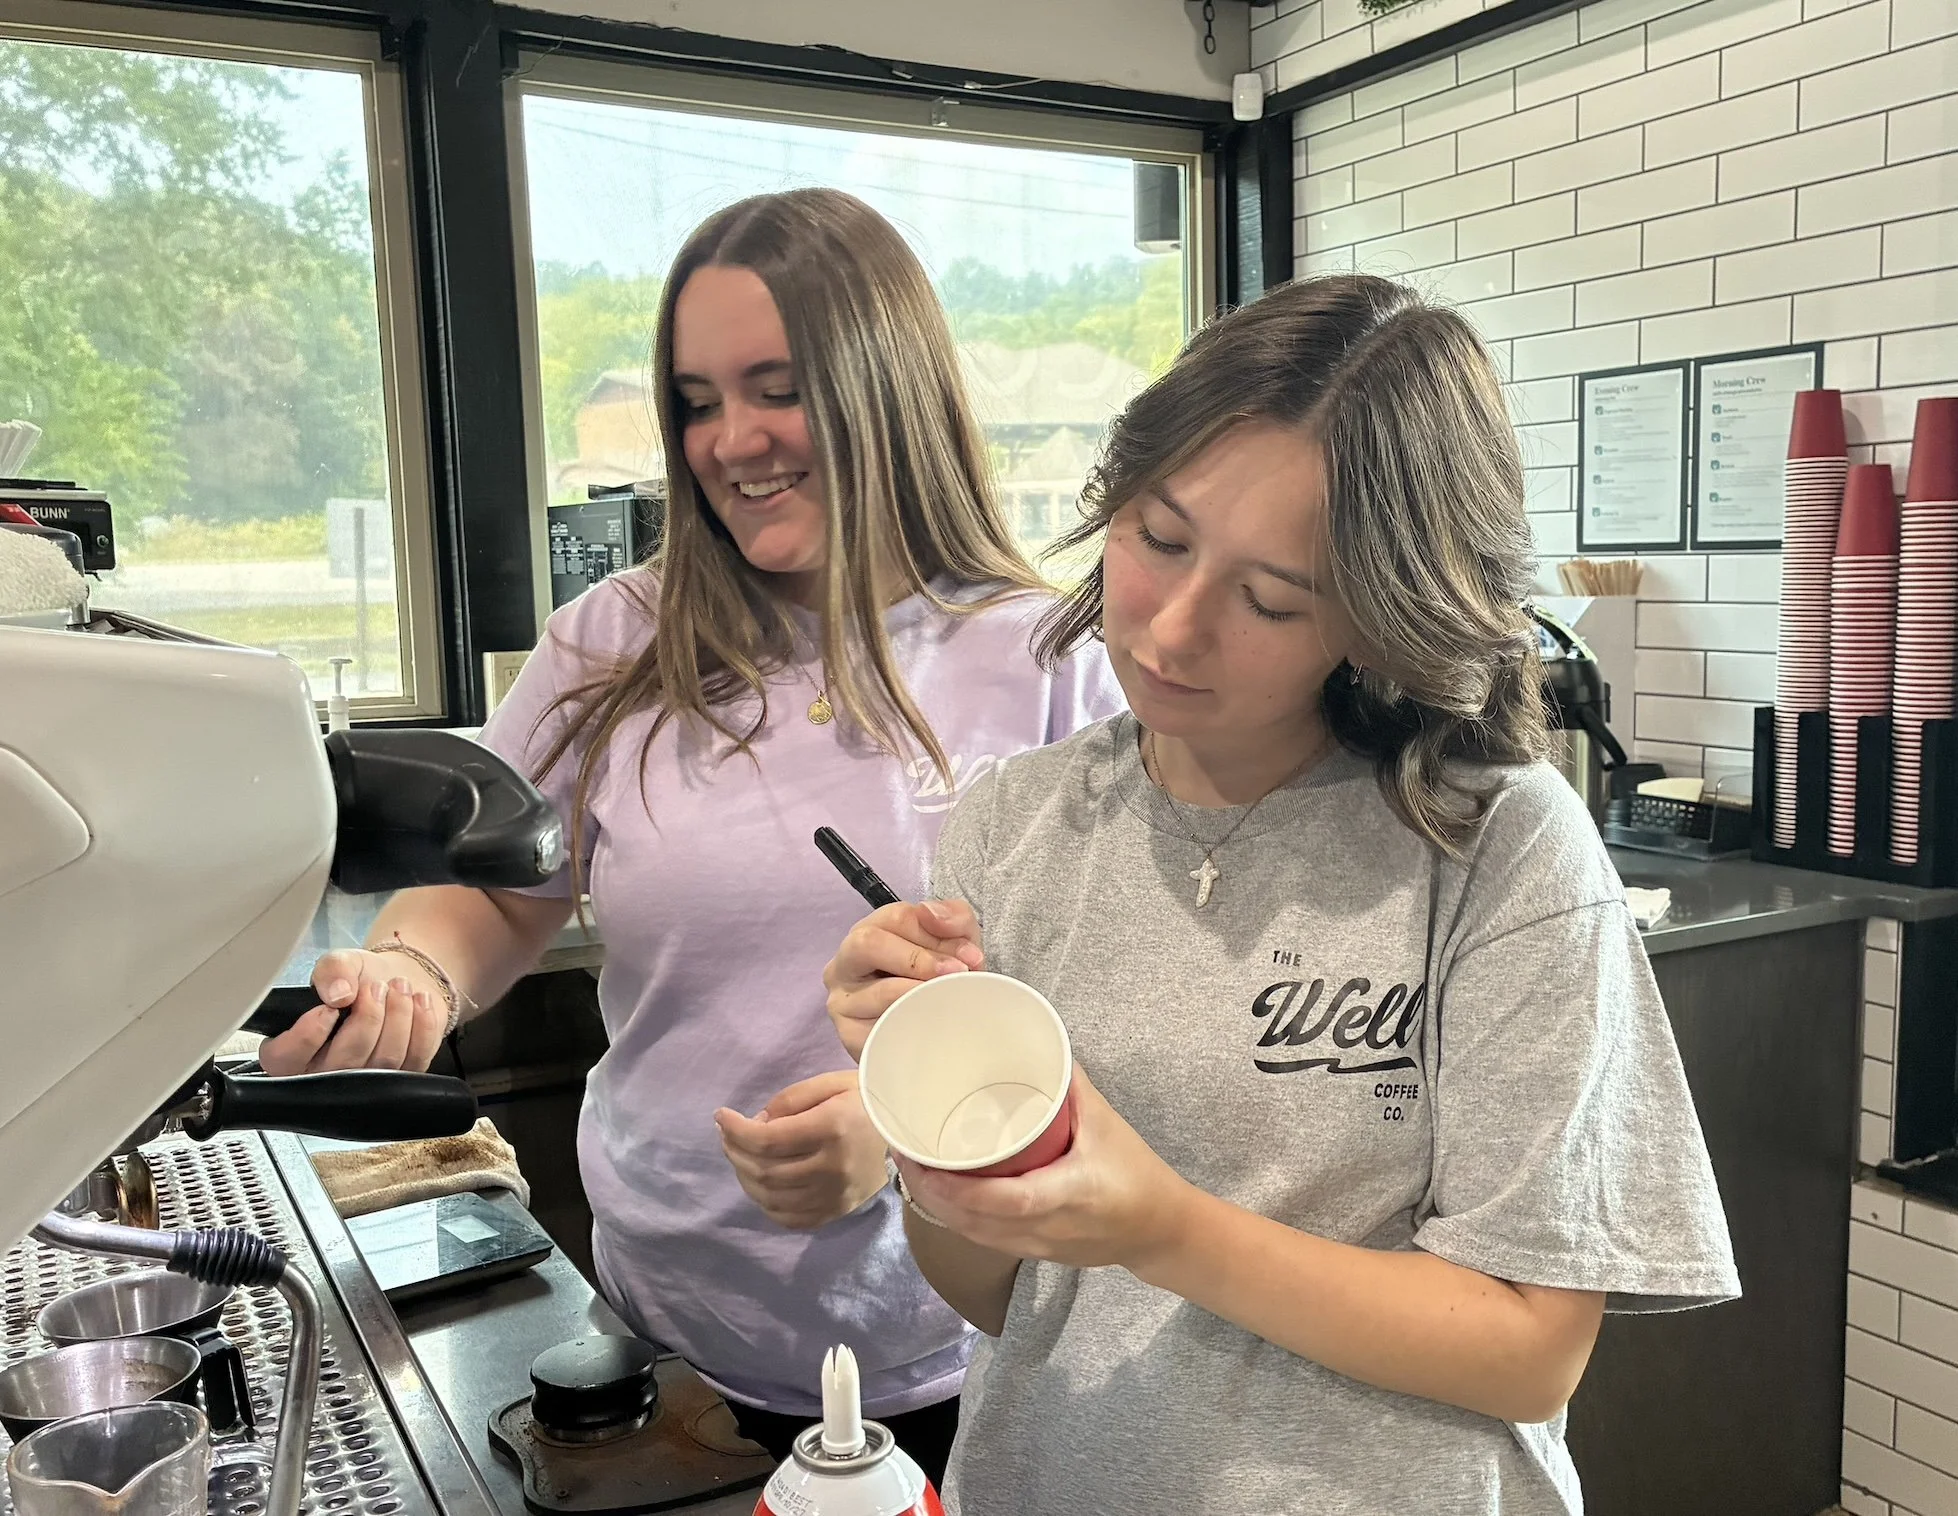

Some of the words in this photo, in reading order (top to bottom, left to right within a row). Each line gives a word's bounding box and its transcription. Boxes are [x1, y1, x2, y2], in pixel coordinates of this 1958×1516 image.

[1594, 386, 1621, 395] Evening
[1621, 384, 1640, 393] Crew
[1712, 379, 1745, 388] Morning
[1746, 376, 1766, 385] Crew
[29, 506, 68, 519] BUNN
[1273, 950, 1302, 967] THE
[1251, 977, 1426, 1050] Well
[1374, 1083, 1419, 1099] COFFEE
[1383, 1106, 1404, 1122] CO.
